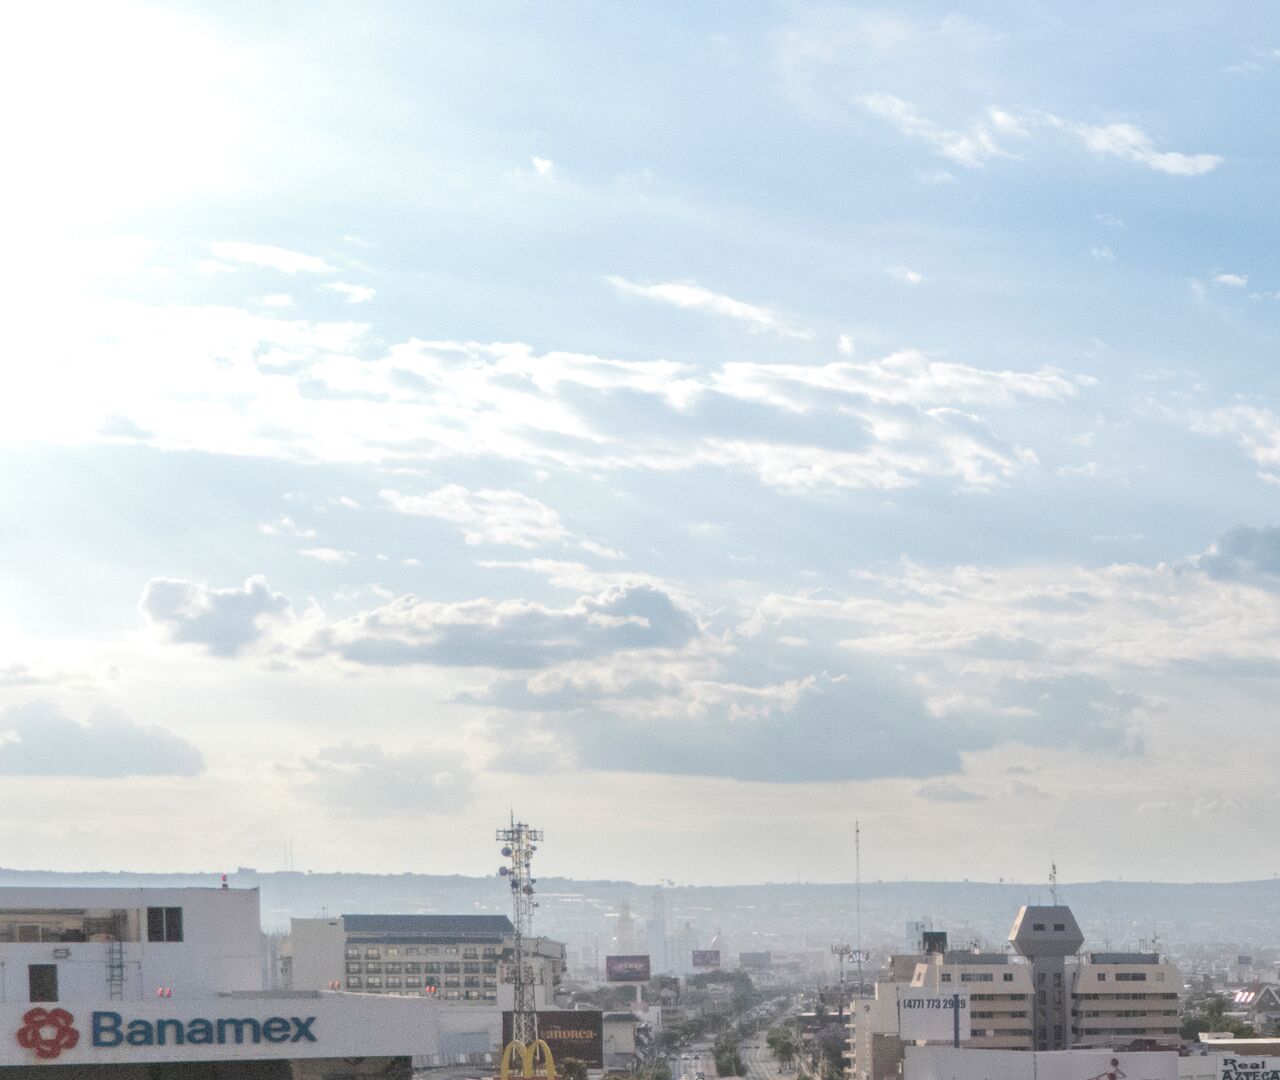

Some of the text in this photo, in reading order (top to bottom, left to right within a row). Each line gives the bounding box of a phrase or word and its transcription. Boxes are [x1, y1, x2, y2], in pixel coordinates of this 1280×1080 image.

[943, 998, 966, 1009] 299
[91, 1010, 318, 1048] Banamex
[1223, 1059, 1265, 1071] Real
